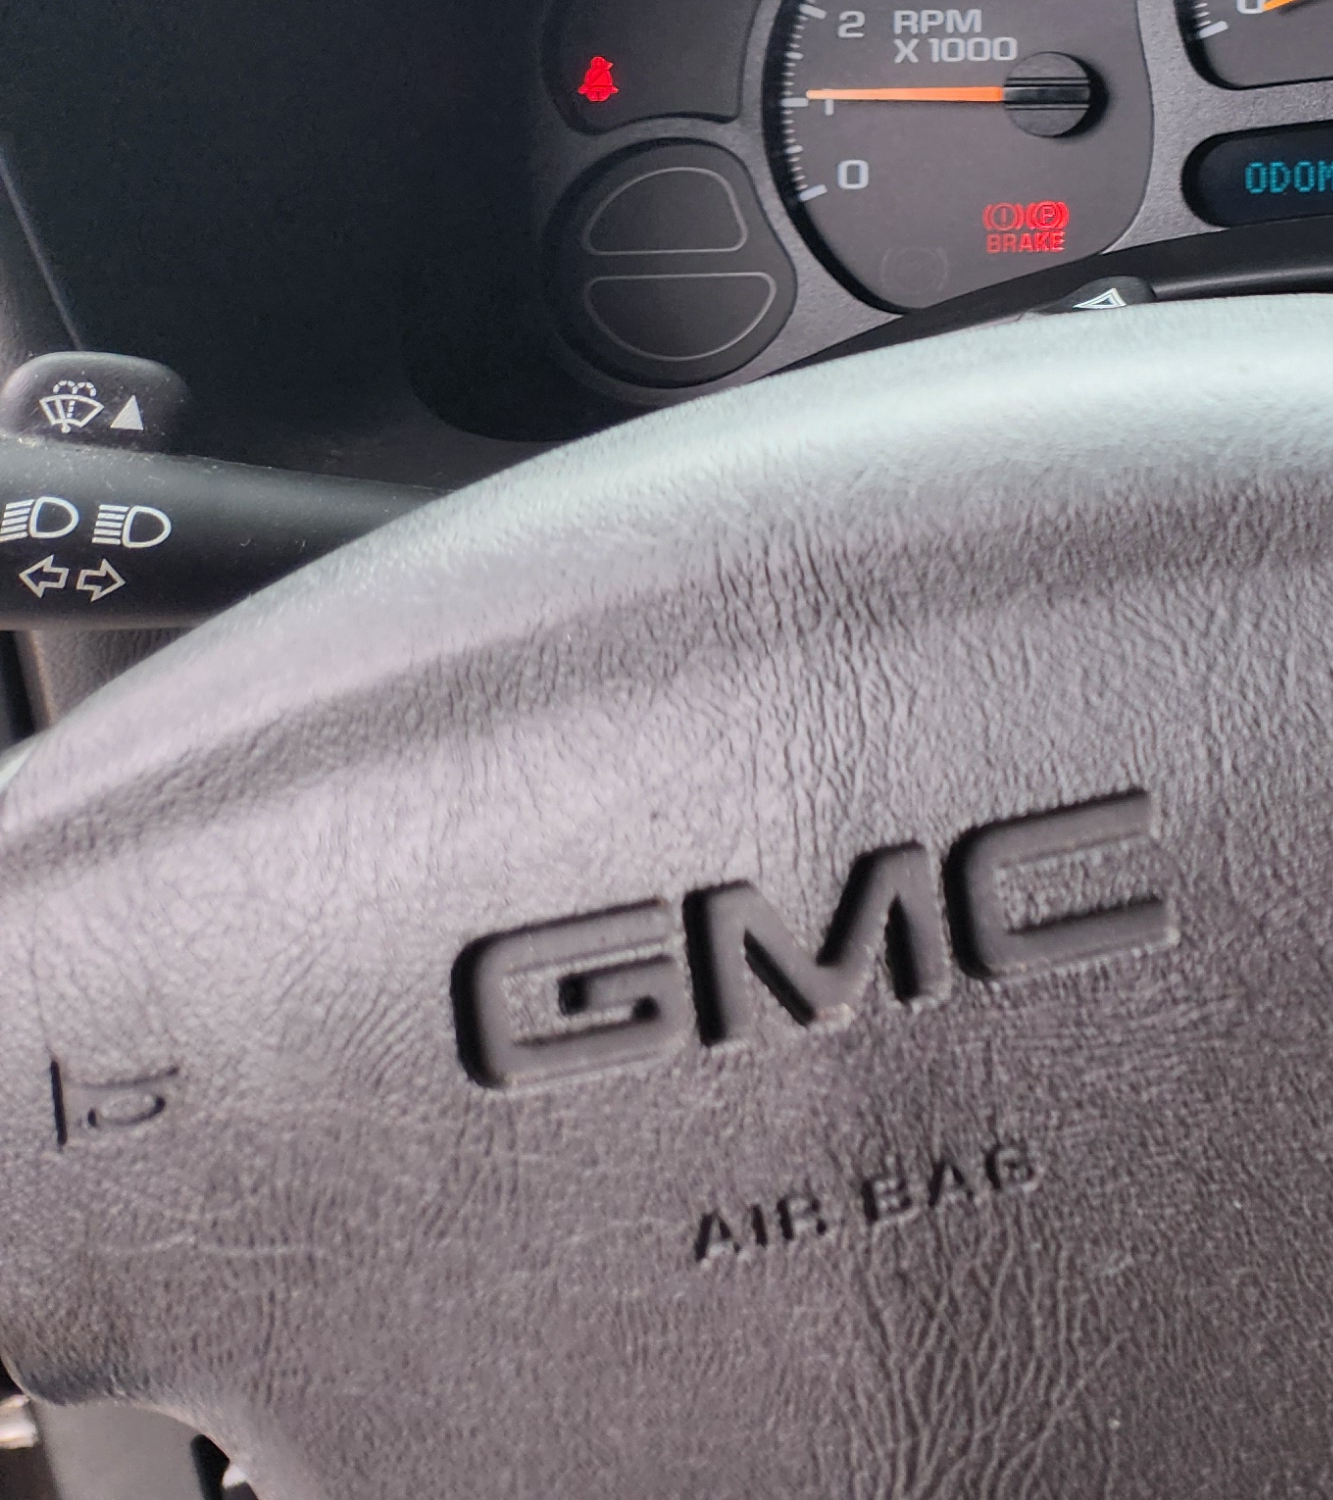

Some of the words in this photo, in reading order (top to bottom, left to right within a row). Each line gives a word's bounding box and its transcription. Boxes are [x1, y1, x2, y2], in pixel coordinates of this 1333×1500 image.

[838, 11, 865, 37] 2
[894, 9, 982, 34] RPM
[839, 160, 869, 189] 0
[986, 232, 1064, 253] BRAKE
[450, 786, 1177, 1090] GMC
[694, 1193, 827, 1264] AIR
[862, 1142, 1039, 1223] BAG
